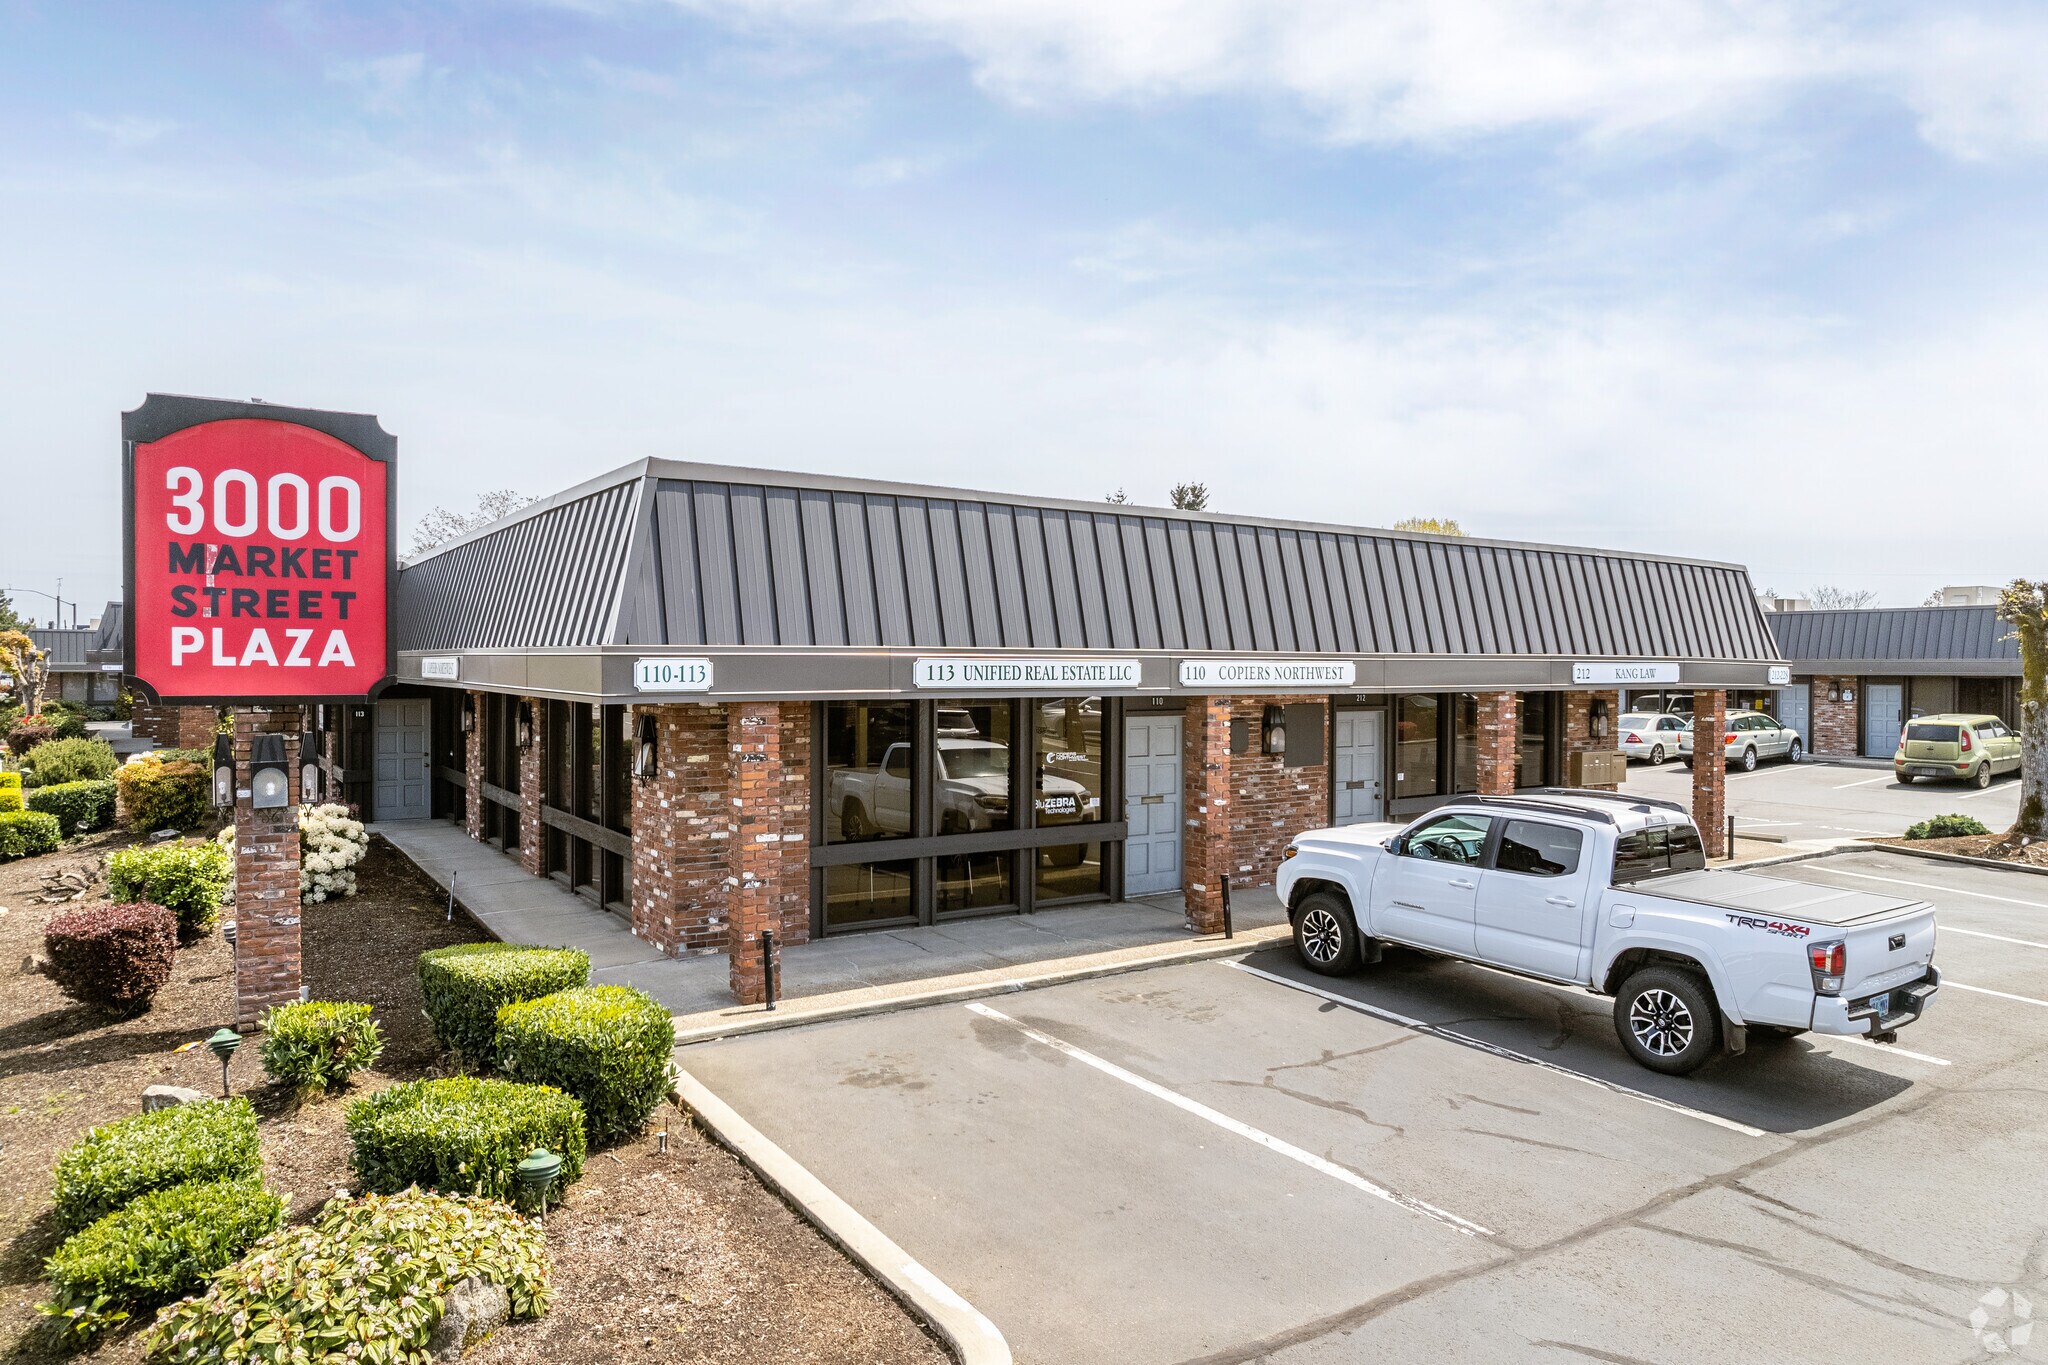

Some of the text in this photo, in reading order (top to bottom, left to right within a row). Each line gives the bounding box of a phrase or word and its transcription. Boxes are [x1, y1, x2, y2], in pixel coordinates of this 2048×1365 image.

[166, 466, 360, 542] 3000
[169, 541, 358, 580] MARKET
[170, 584, 357, 620] STREET
[171, 626, 356, 667] PLAZA
[642, 664, 706, 684] 110-113
[927, 664, 1132, 682] 113 UNIFIED REAL ESTATE LLC
[1186, 665, 1344, 681] 110 COPIERS NORTHWEST
[1576, 668, 1657, 680] 212 KANG LAW
[1152, 697, 1164, 706] 110
[1356, 694, 1366, 702] 212
[355, 710, 365, 718] 113
[1766, 928, 1807, 940] SPORT
